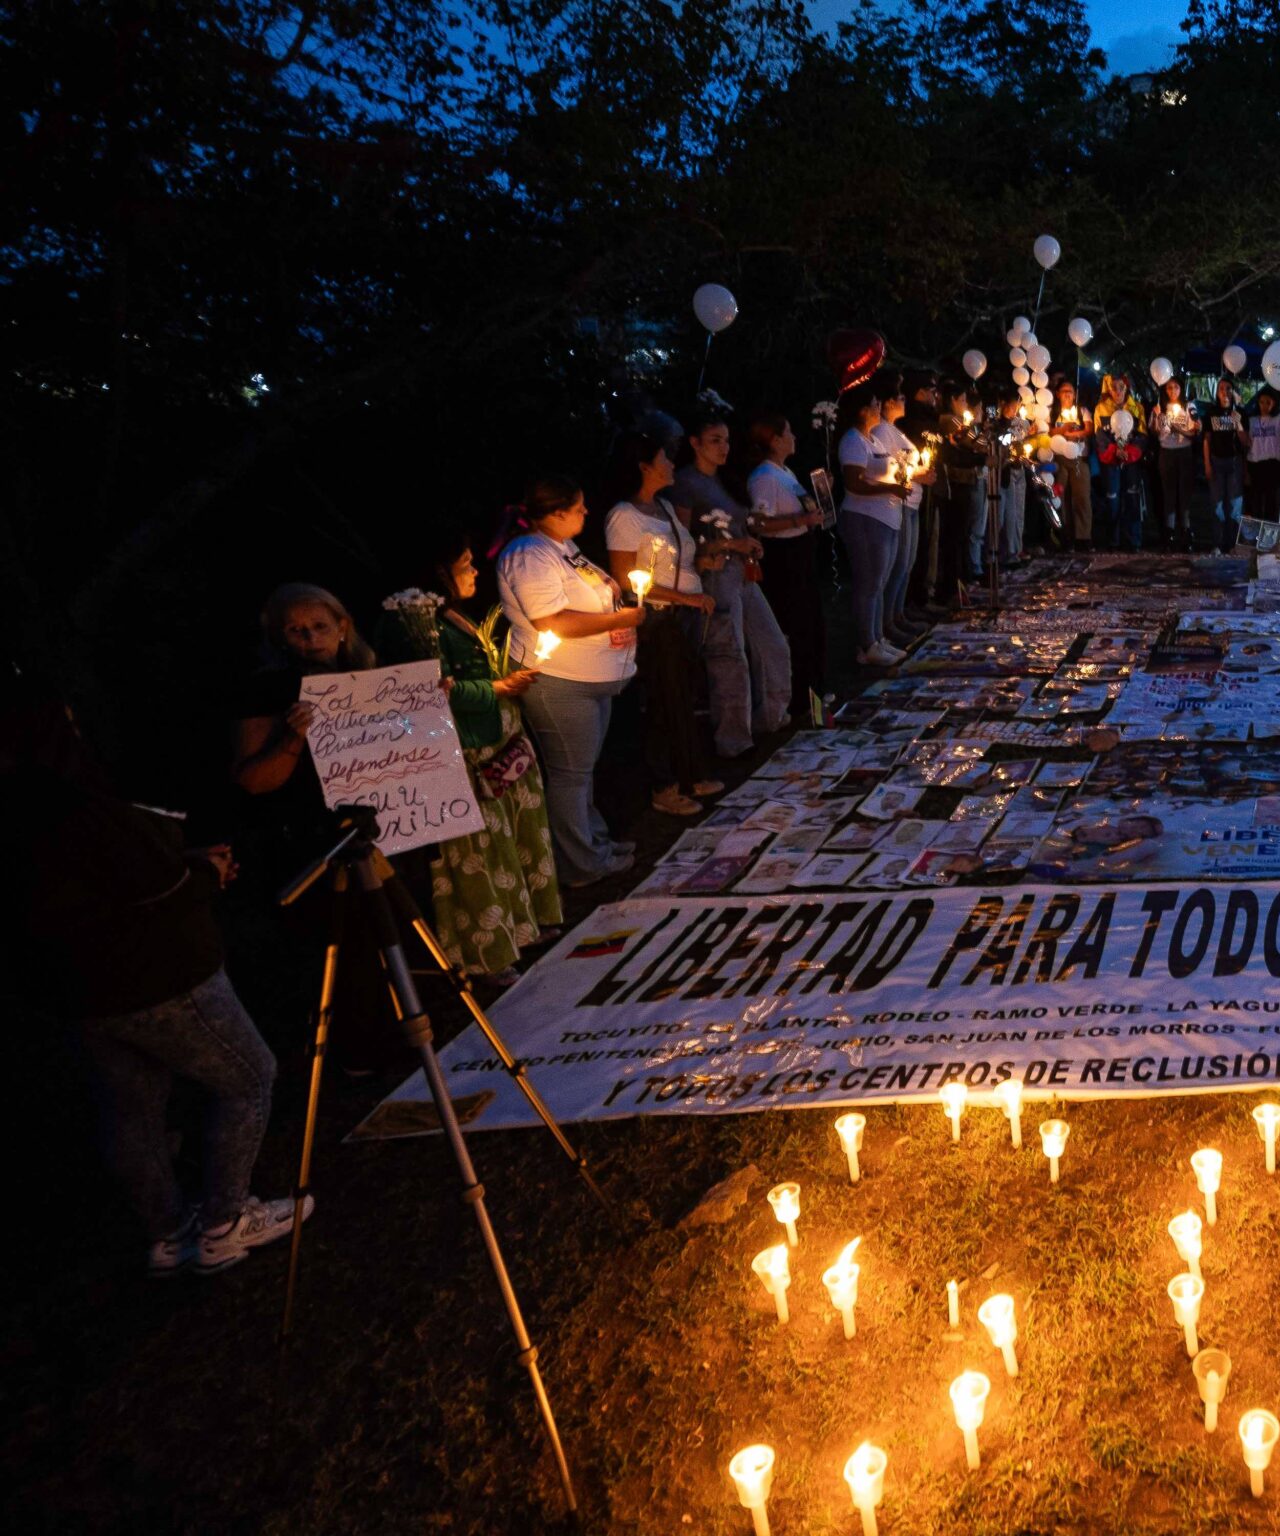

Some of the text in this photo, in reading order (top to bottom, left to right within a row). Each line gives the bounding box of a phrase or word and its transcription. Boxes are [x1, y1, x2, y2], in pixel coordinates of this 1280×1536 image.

[576, 897, 935, 1008] LIBERTAD
[926, 891, 1117, 990] PARA
[559, 1021, 684, 1044] TOCUYITO
[742, 1016, 842, 1034] PLANTA
[861, 1010, 951, 1025] RODEO
[972, 1006, 1049, 1020] RAMO
[1056, 1003, 1144, 1018] VERDE
[1166, 999, 1199, 1013] LA
[903, 1032, 955, 1045] SAN
[959, 1030, 1027, 1044] JUAN
[1033, 1028, 1067, 1041] DE
[1072, 1025, 1122, 1037] LOS
[1128, 1023, 1236, 1036] MORROS
[602, 1077, 637, 1106] Y
[635, 1071, 765, 1104] TODOS
[758, 1067, 838, 1096] LOS
[839, 1060, 1017, 1091] CENTROS
[1021, 1058, 1074, 1085] DE
